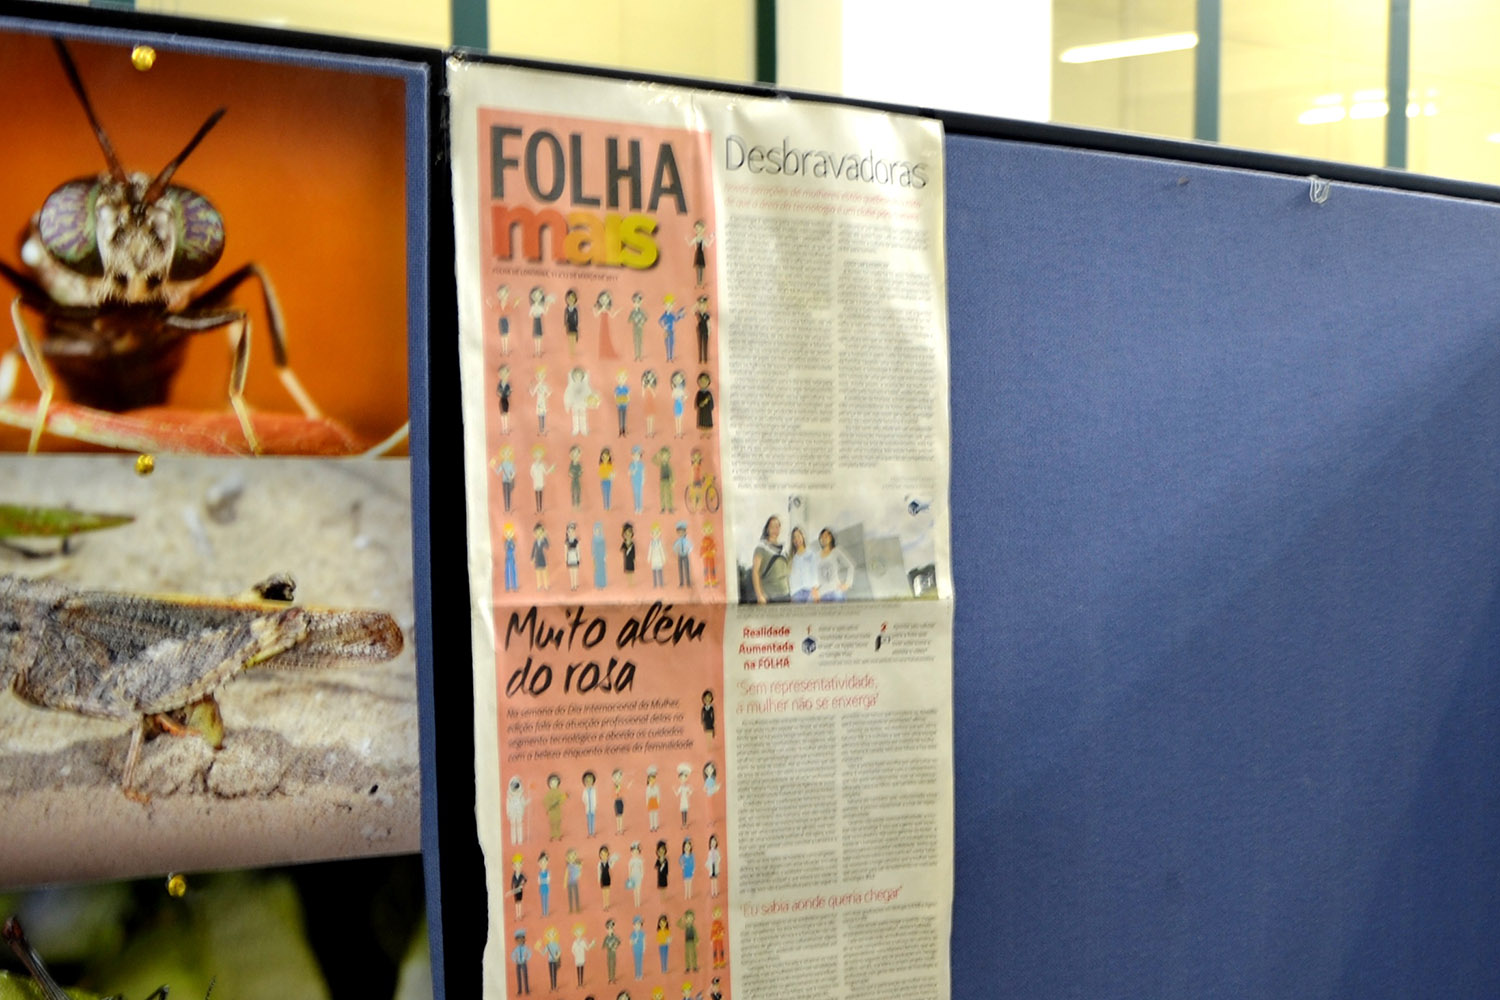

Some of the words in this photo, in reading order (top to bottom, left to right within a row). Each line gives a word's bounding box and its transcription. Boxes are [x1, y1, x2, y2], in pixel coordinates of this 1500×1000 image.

[490, 125, 688, 215] FOLHA
[725, 134, 929, 190] Desbravadoras
[491, 204, 659, 270] mais
[505, 605, 607, 652] Muito
[616, 600, 706, 649] além
[743, 625, 791, 639] Realidade
[738, 640, 795, 656] Aumentada
[743, 661, 756, 671] na
[757, 655, 791, 670] FOLHA
[505, 656, 553, 698] do
[563, 656, 636, 695] rosa
[769, 672, 878, 695] representatividade,
[520, 706, 553, 718] semana
[567, 703, 582, 715] Dia
[583, 699, 638, 714] Internacional
[735, 703, 744, 715] a
[746, 697, 787, 715] mulher
[791, 696, 813, 711] não
[815, 697, 830, 710] se
[565, 717, 600, 730] atuação
[600, 713, 649, 729] profissional
[508, 736, 548, 749] segmento
[549, 732, 598, 747] tecnológico
[647, 725, 684, 738] cuidados
[533, 748, 562, 761] beleza
[562, 745, 603, 760] enquanto
[761, 898, 789, 915] sabia
[791, 894, 826, 914] aonde
[827, 889, 863, 910] queria
